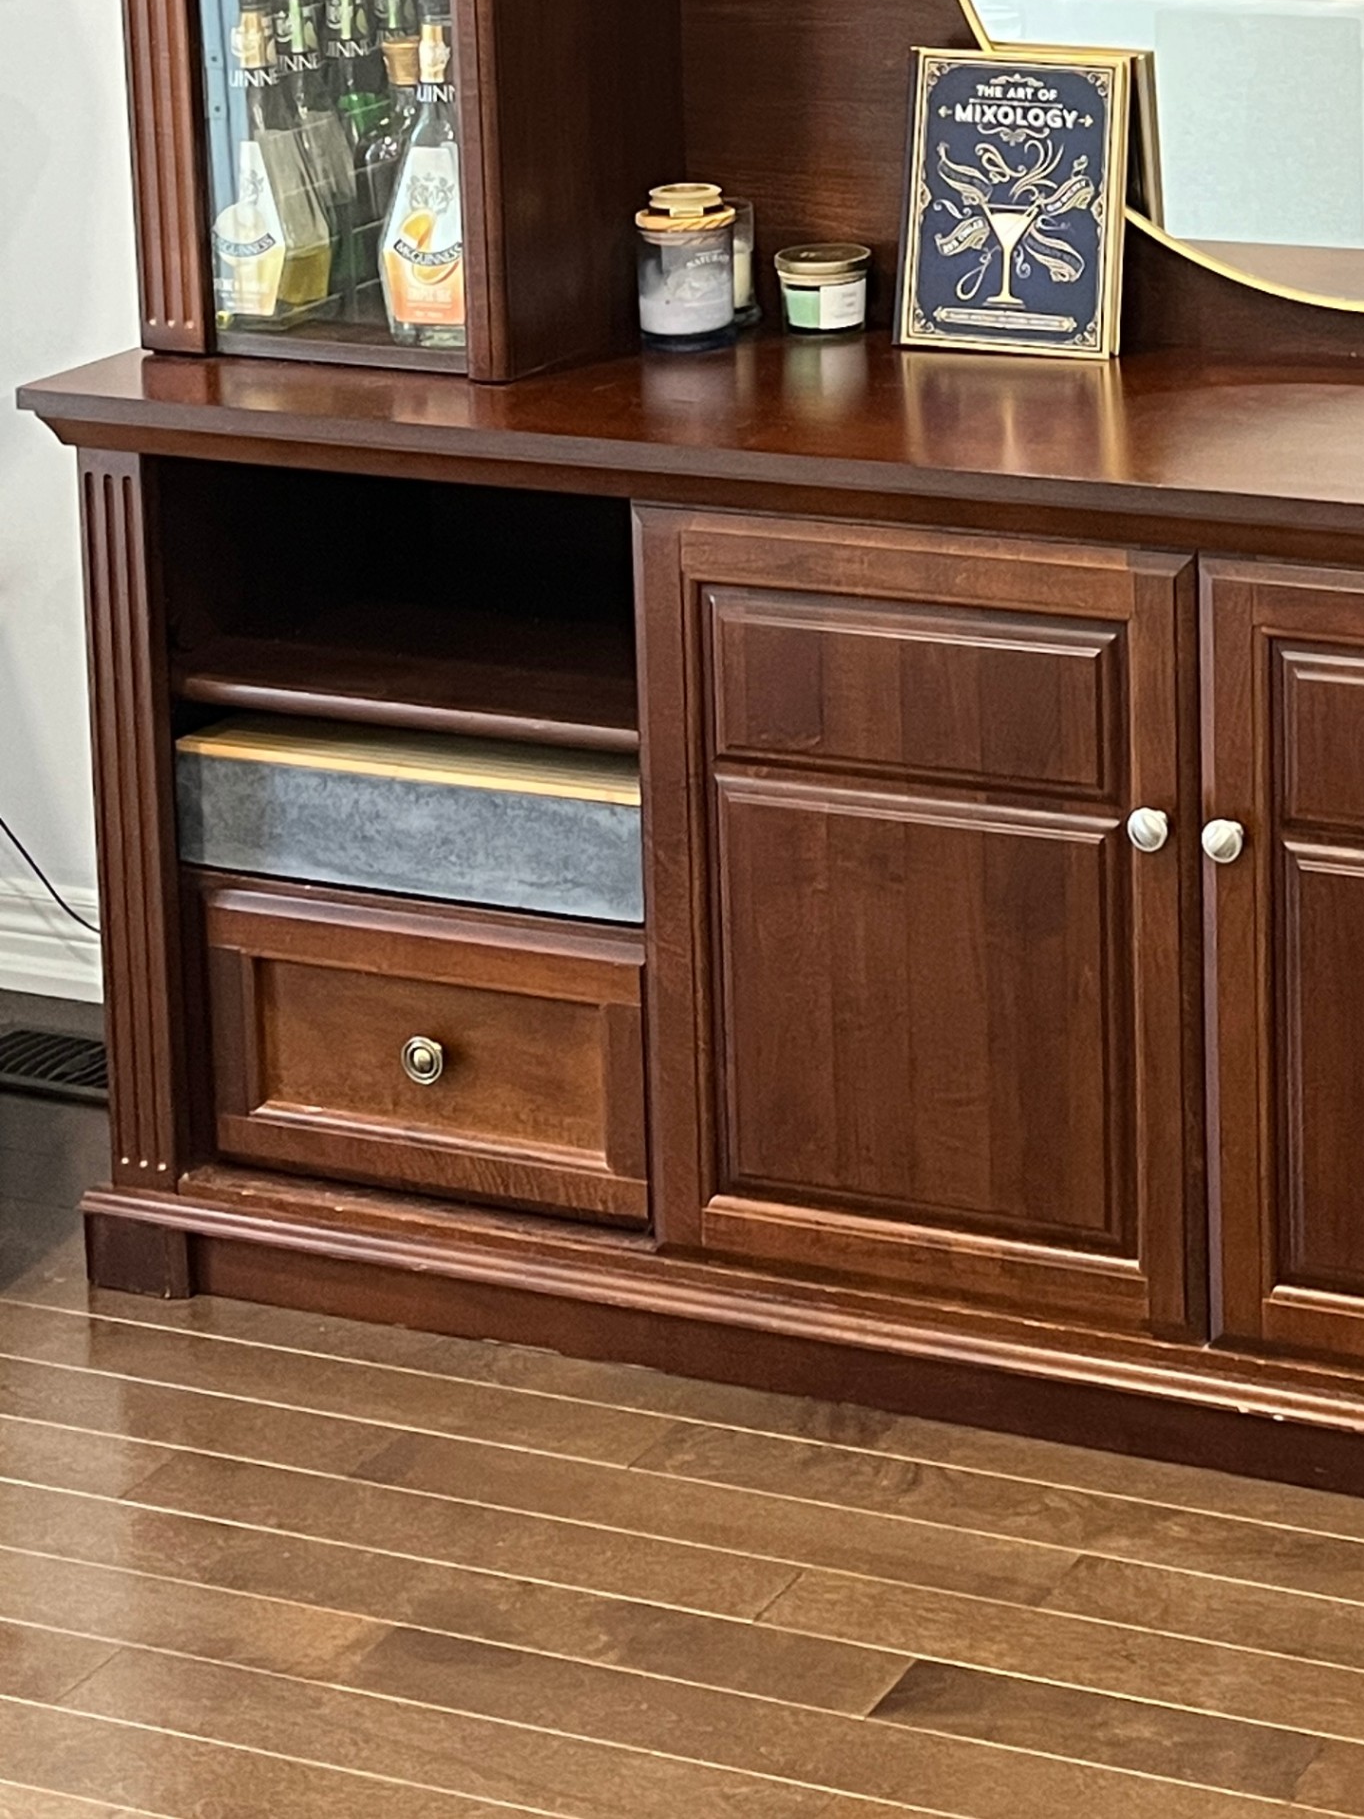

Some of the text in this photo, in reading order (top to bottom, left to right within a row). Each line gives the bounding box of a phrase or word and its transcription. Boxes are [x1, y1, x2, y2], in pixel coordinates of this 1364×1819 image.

[976, 84, 1058, 101] THE ART OF
[954, 102, 1078, 129] MIXOLOGY
